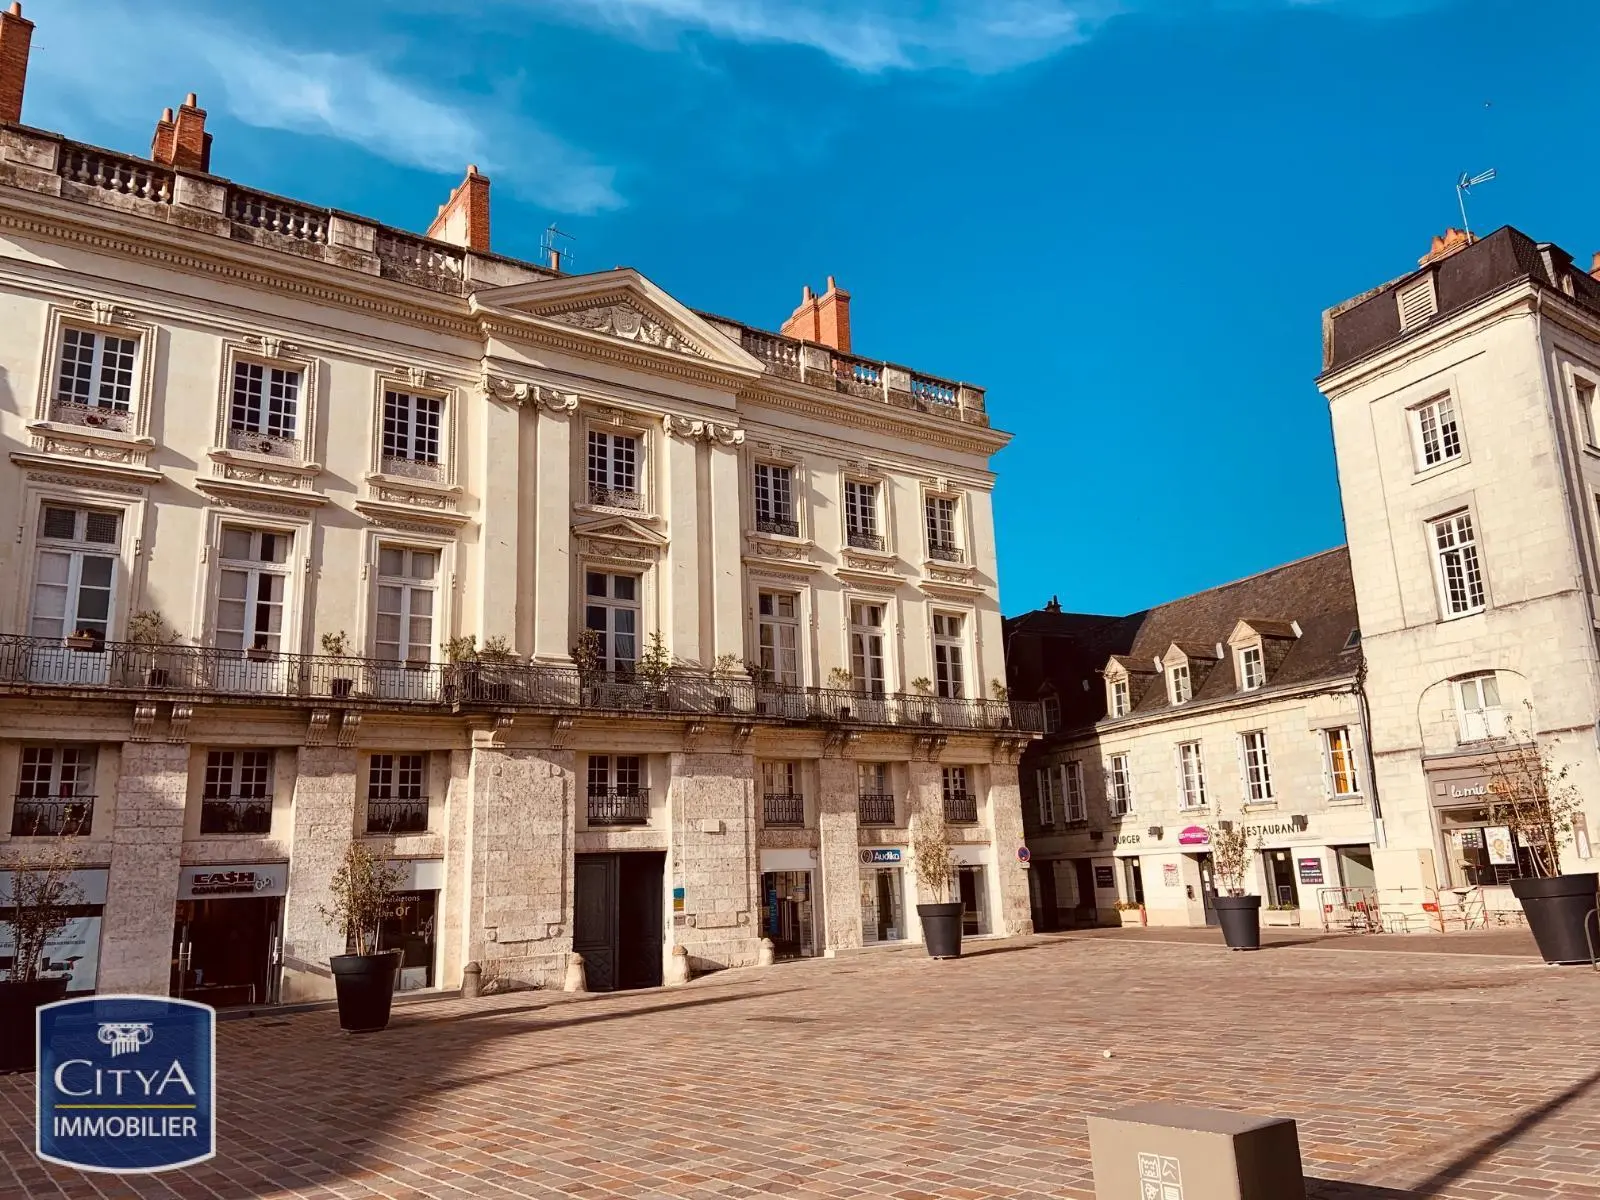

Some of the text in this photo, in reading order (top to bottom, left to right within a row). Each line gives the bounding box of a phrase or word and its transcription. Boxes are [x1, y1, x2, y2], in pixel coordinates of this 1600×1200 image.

[1113, 834, 1140, 845] BURGER
[874, 851, 900, 860] Audika
[395, 906, 411, 917] or
